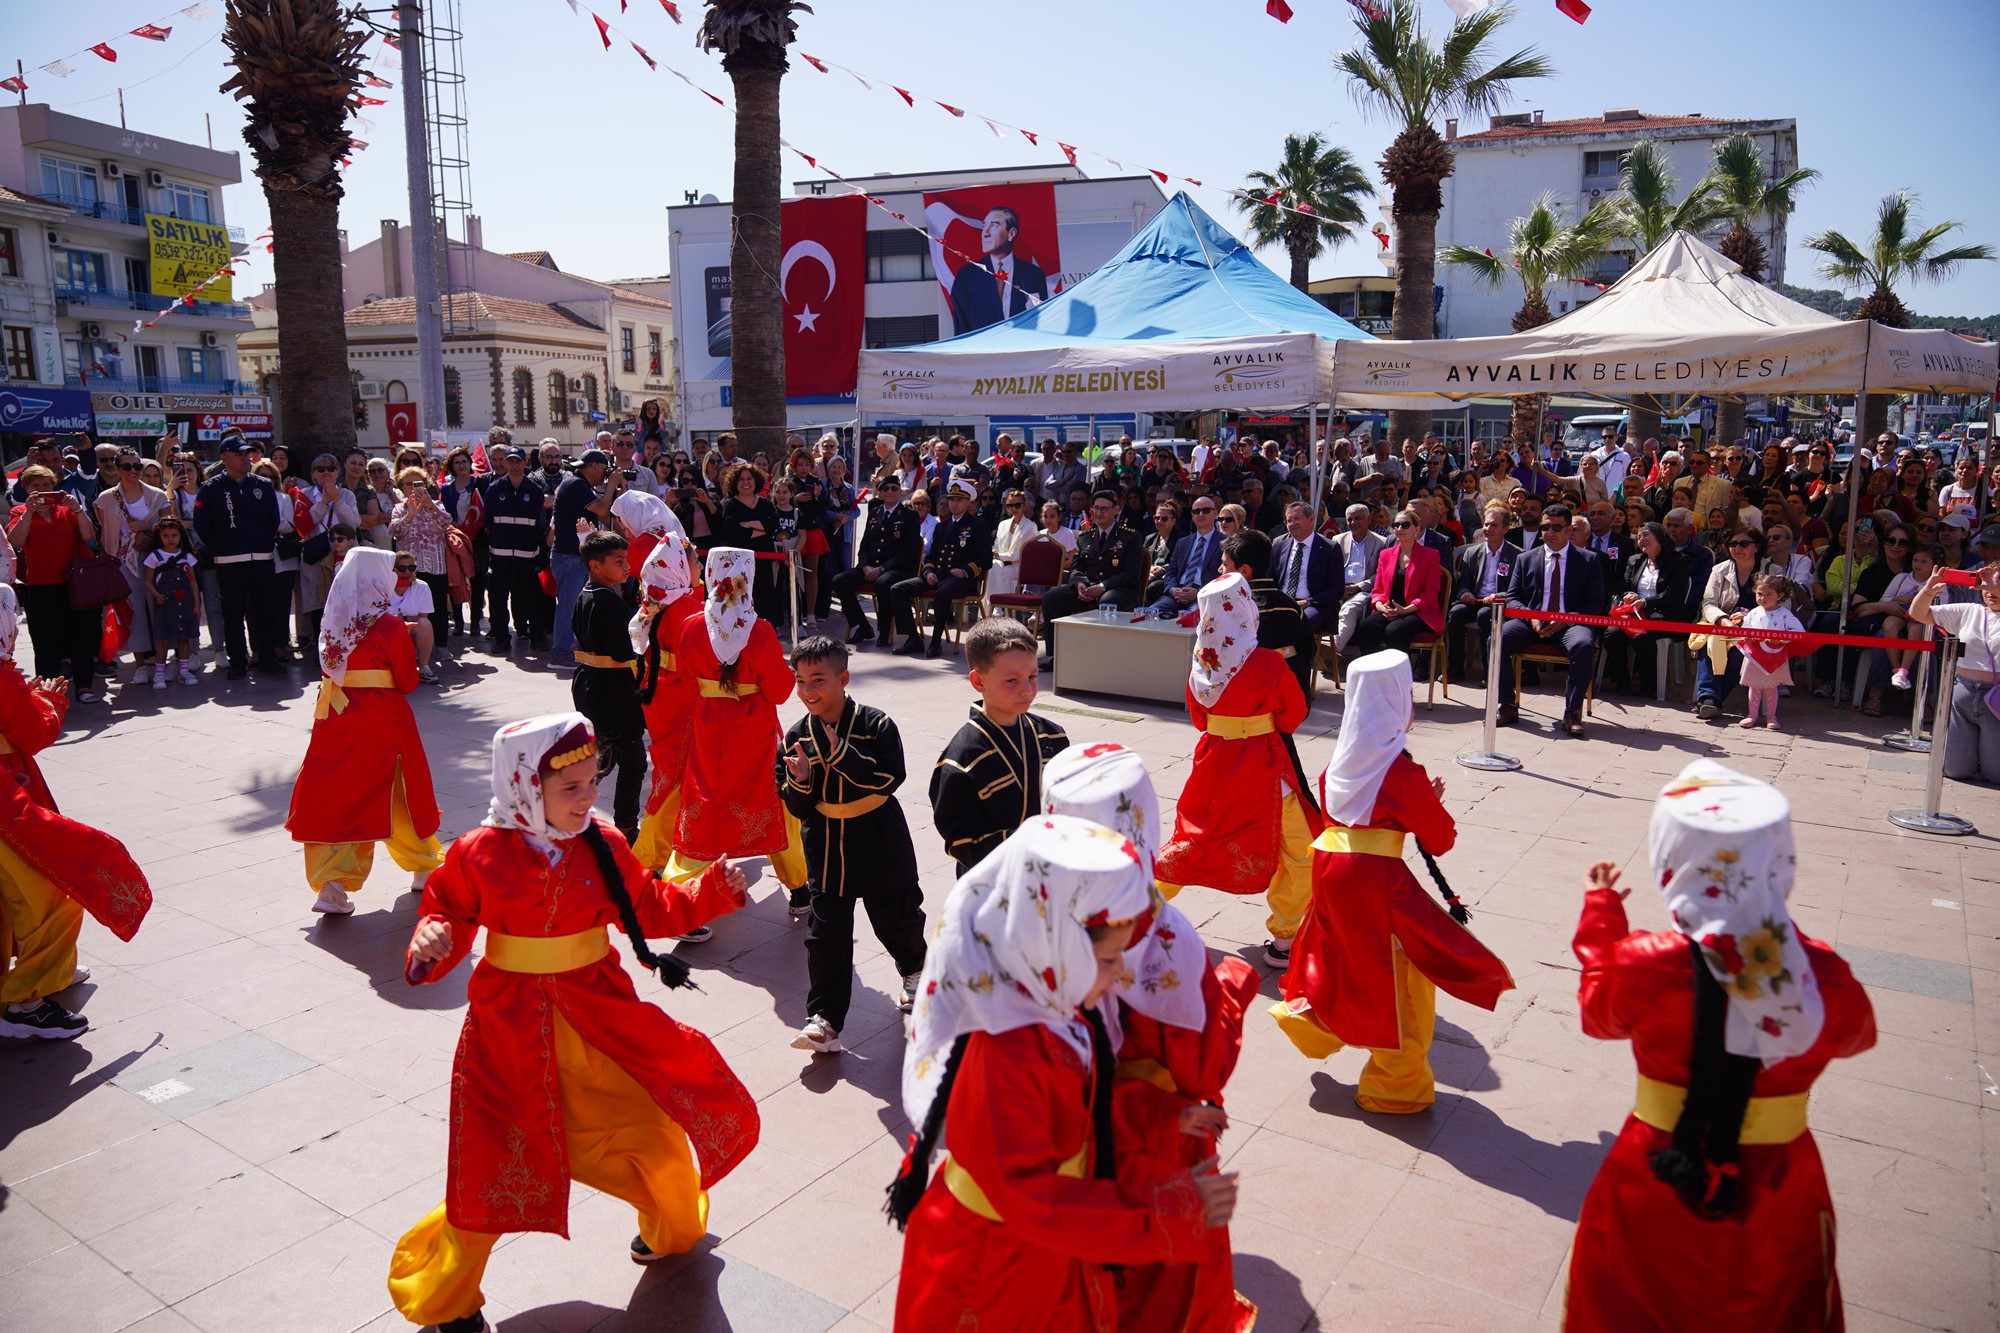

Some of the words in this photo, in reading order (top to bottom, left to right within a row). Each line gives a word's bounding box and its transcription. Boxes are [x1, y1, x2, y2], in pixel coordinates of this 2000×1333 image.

[151, 219, 226, 248] SATILIK
[155, 243, 179, 258] 0532
[184, 247, 200, 260] 327
[1213, 353, 1284, 365] AYVALIK
[1923, 353, 1964, 373] AYVALIK
[882, 370, 936, 378] AYVALIK
[1446, 362, 1578, 382] AYVALIK
[1593, 355, 1789, 381] BELEDİYESİ
[971, 375, 1048, 396] AYVALIK
[1052, 365, 1166, 393] BELEDİYESİ
[109, 395, 171, 411] OTEL
[224, 491, 236, 528] ZABITA
[1549, 614, 1581, 622] AYVALIK
[1712, 628, 1748, 636] AYVALIK
